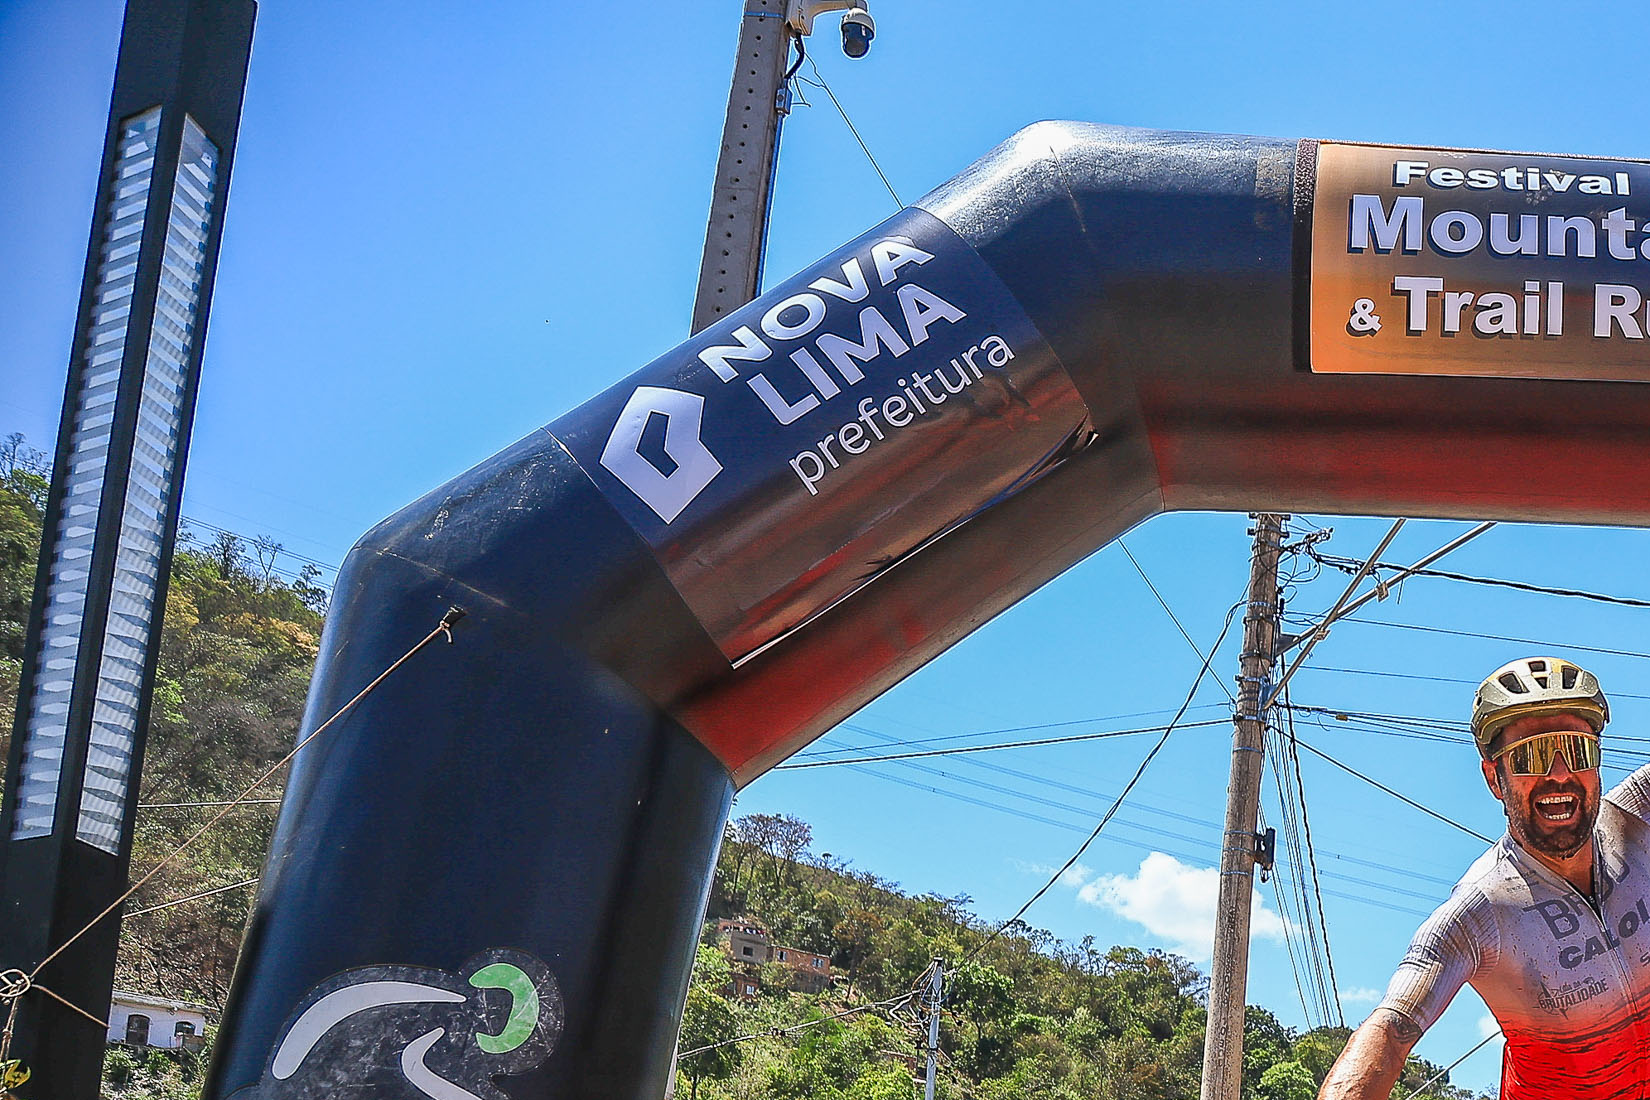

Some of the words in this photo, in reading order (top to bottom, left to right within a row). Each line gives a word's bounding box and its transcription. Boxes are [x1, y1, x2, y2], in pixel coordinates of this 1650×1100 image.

[1392, 159, 1633, 197] Festival
[698, 236, 936, 383] NOVA
[746, 283, 967, 425] LIMA
[1347, 297, 1381, 335] &
[1394, 275, 1565, 338] Trail
[789, 334, 1016, 495] prefeitura
